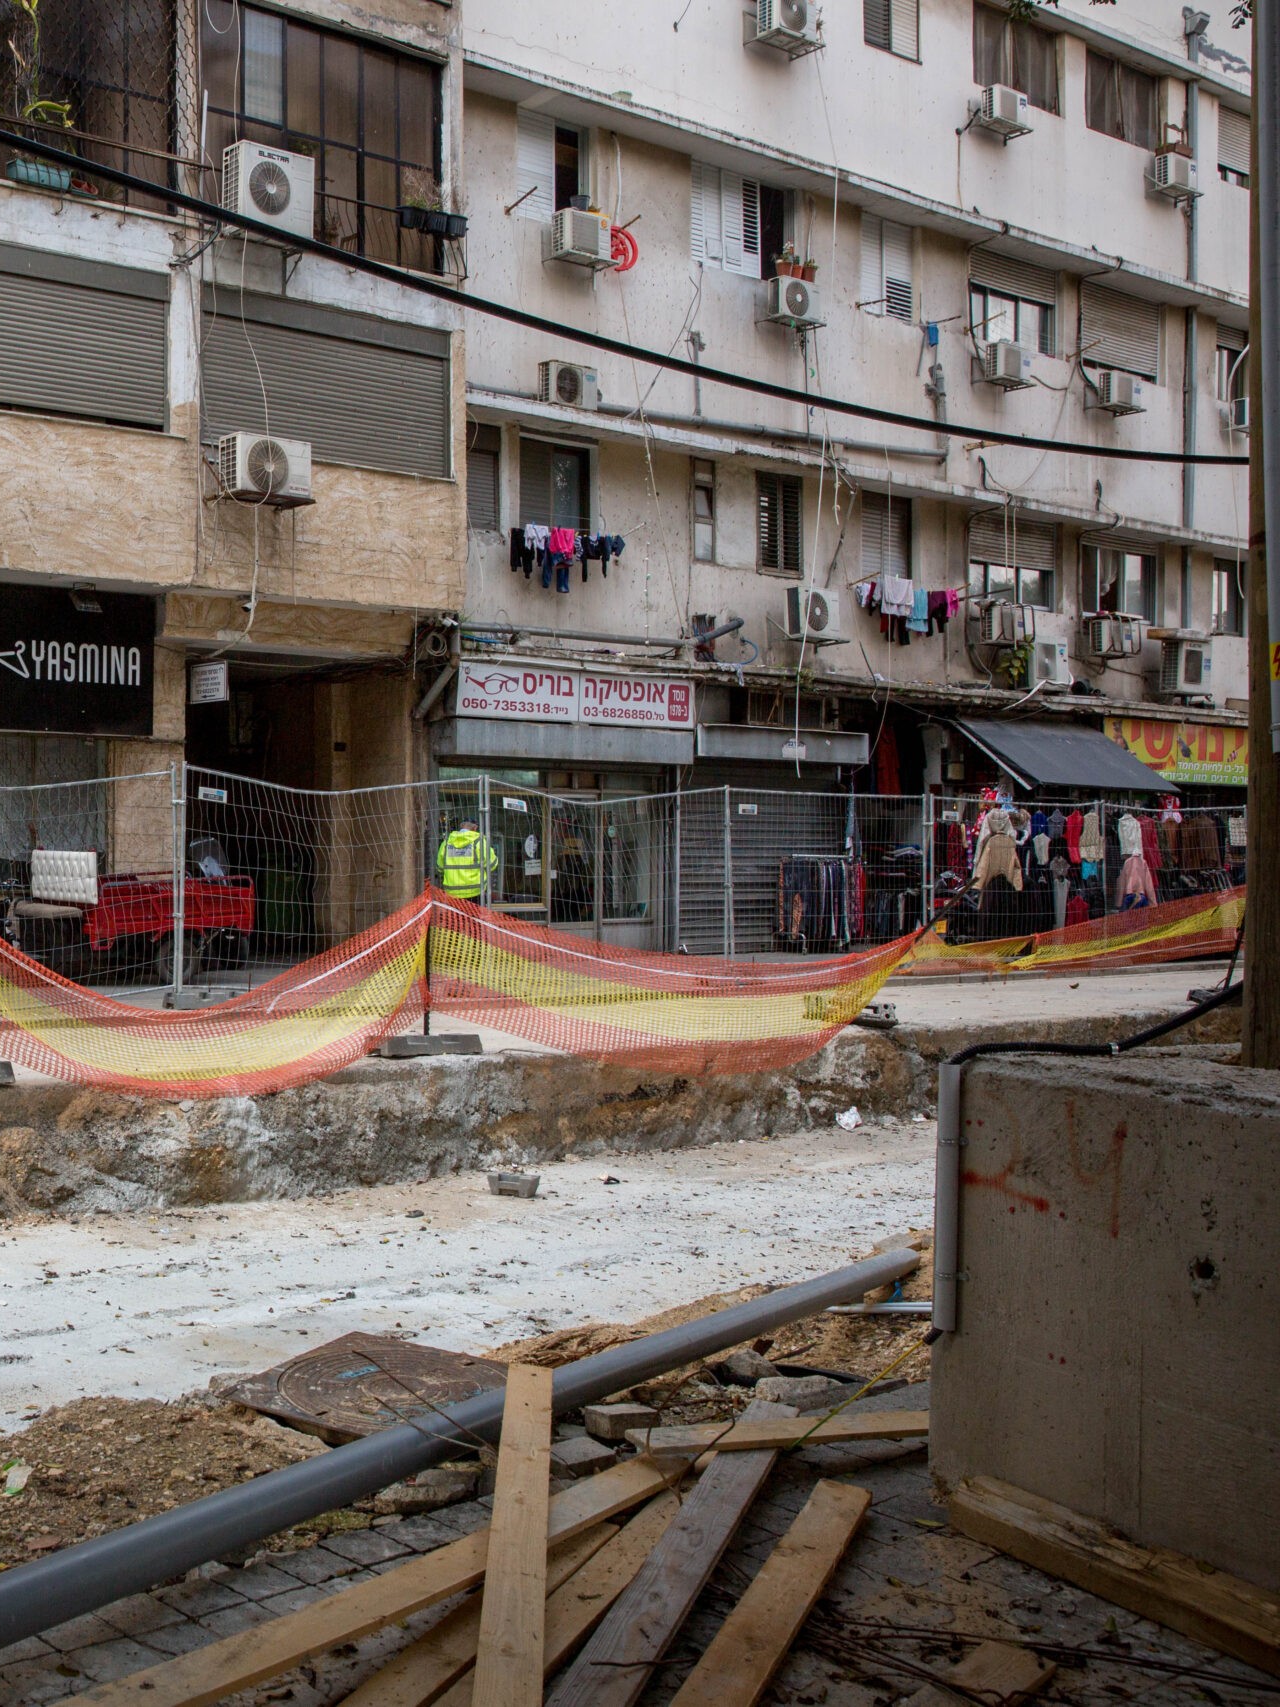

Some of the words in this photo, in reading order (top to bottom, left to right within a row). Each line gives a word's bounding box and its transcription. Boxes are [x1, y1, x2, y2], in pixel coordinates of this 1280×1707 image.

[31, 640, 141, 686] YASMINA
[523, 672, 574, 697] בוריס
[584, 678, 665, 705] אופטיקה
